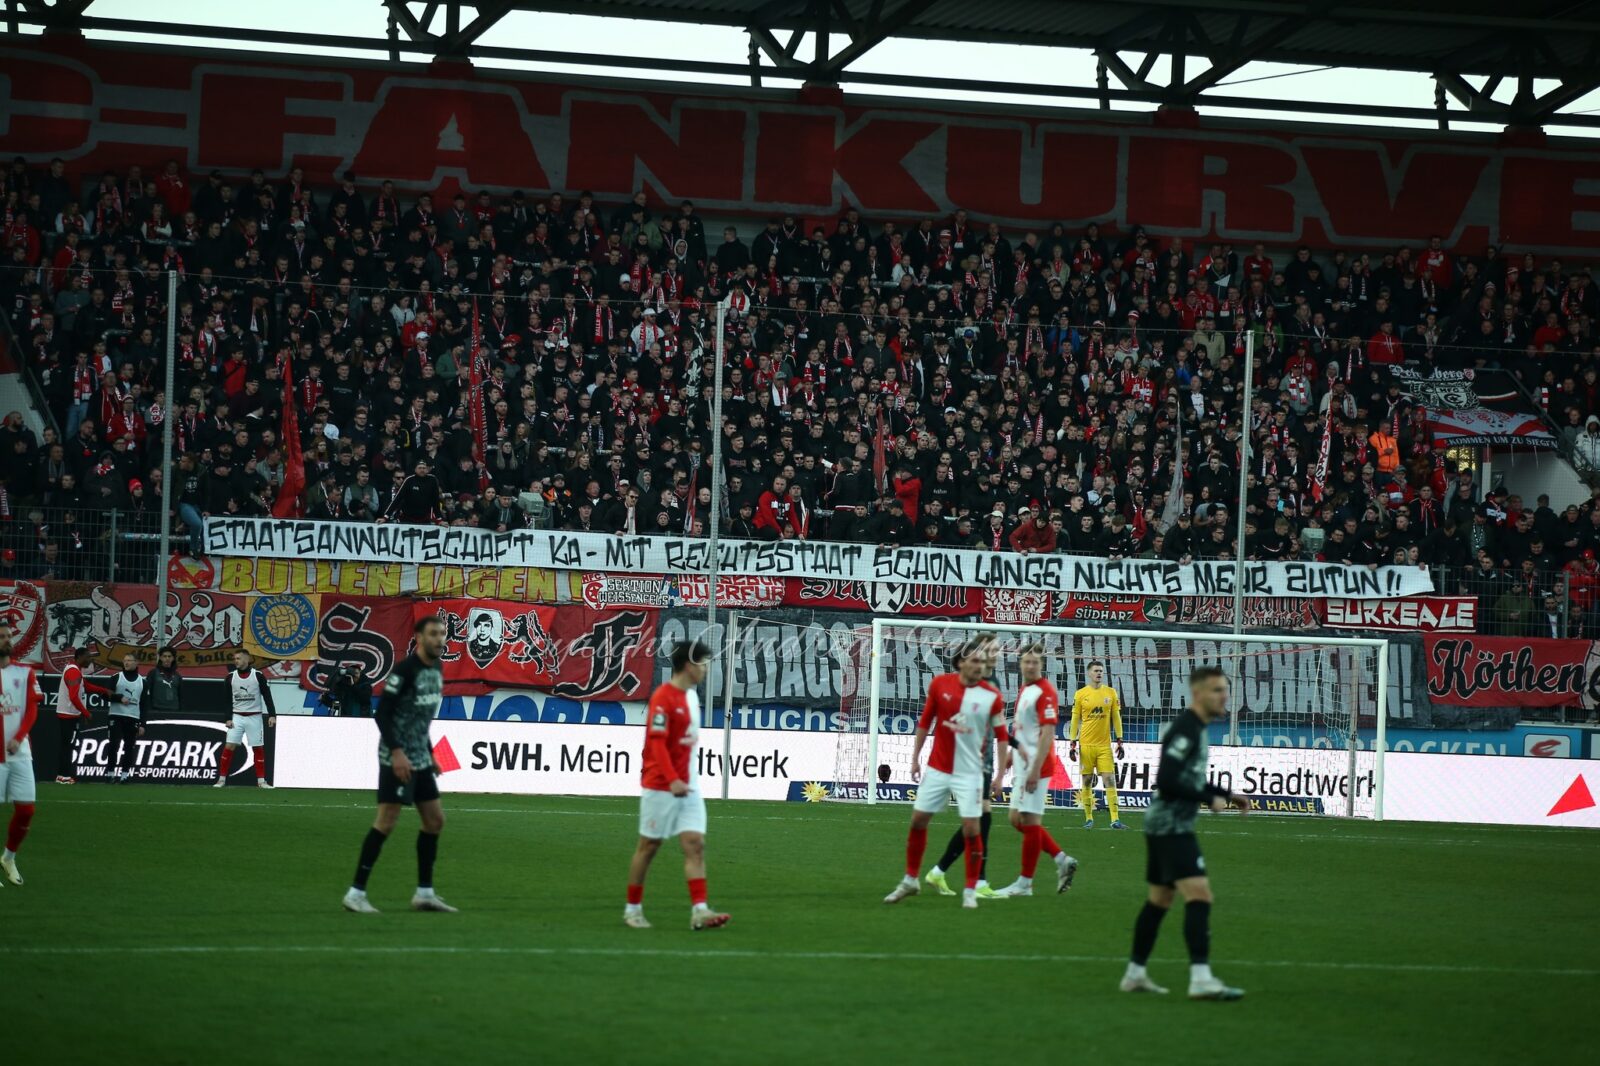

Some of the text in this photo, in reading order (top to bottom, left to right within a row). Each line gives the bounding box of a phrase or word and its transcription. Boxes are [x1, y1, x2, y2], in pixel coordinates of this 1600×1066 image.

[606, 537, 651, 568] MIT
[873, 550, 963, 583] SCHON
[975, 554, 1062, 588] LANGE
[1075, 562, 1182, 594] NICHTS
[607, 578, 660, 593] SEKTION
[599, 590, 670, 606] WEISSENFELS
[1075, 606, 1134, 621] SÜDHARZ
[1428, 638, 1586, 700] Köthen
[470, 741, 550, 772] SWH.
[560, 744, 630, 774] Mein
